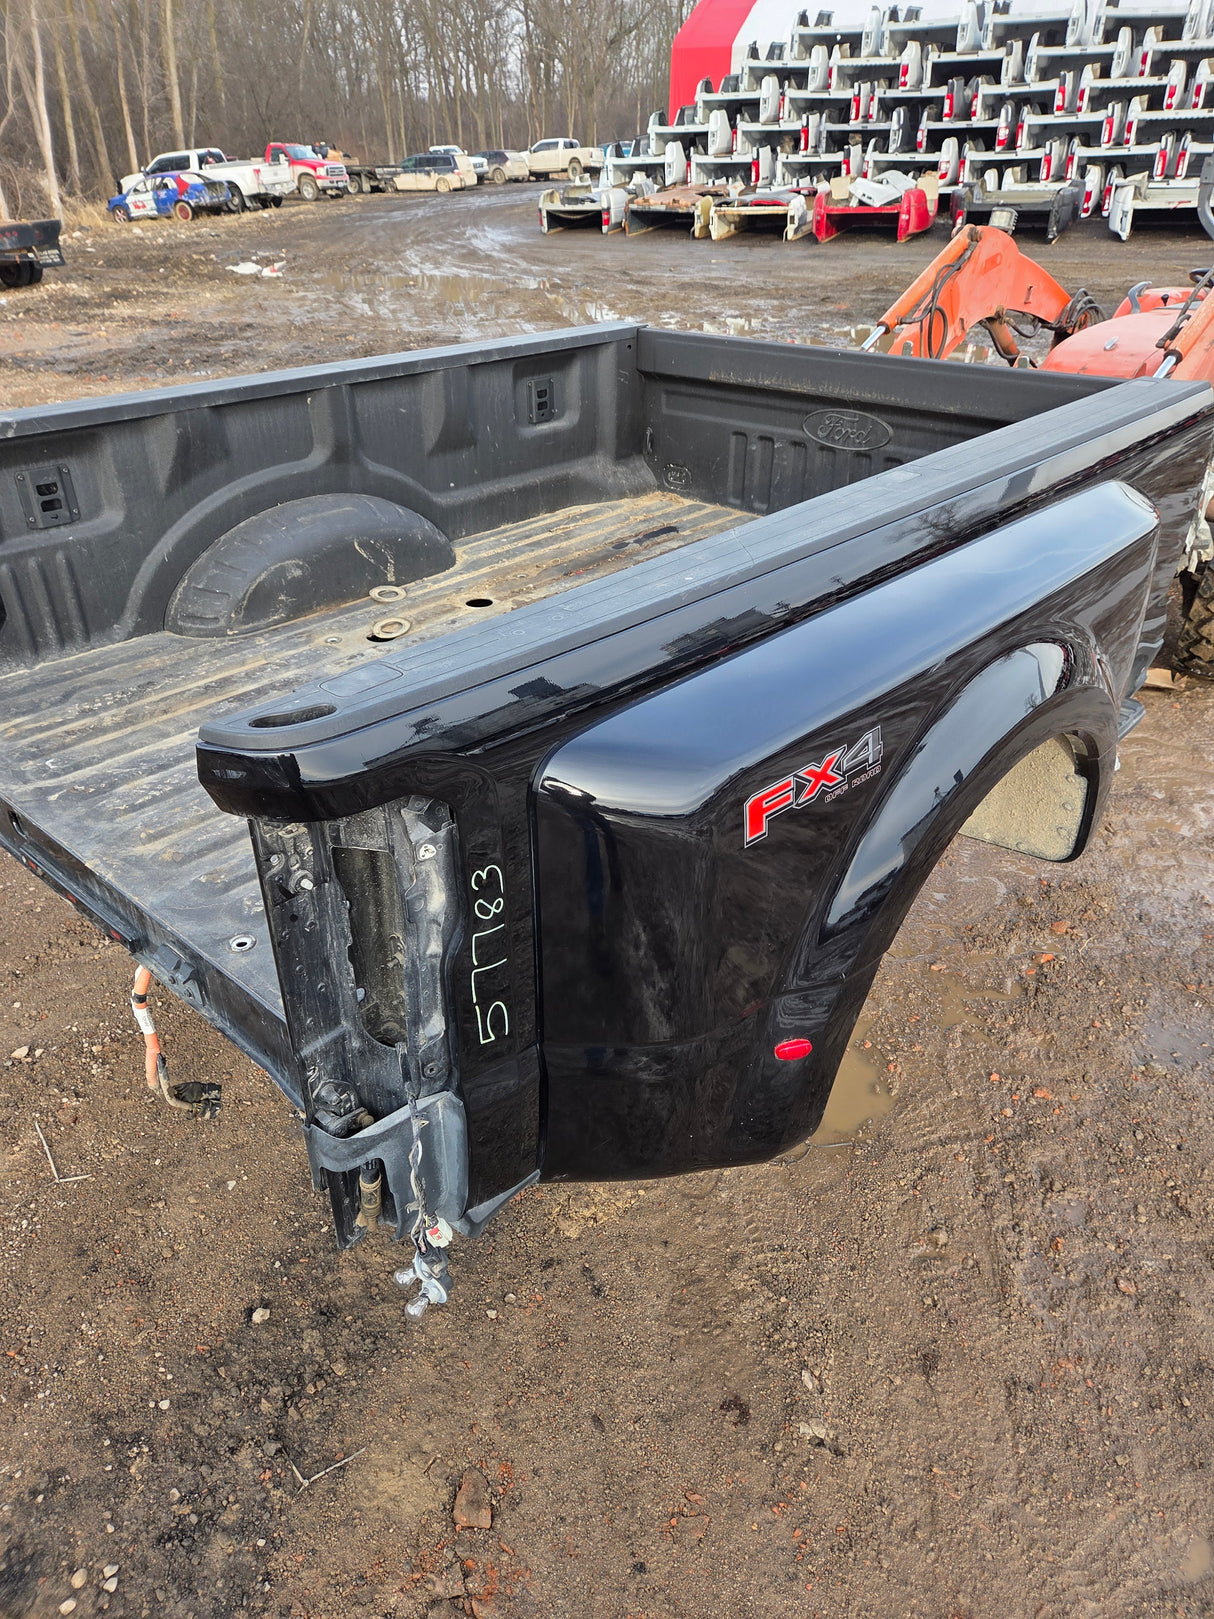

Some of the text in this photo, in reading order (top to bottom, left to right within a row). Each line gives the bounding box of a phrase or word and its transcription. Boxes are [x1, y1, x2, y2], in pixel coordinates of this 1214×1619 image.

[817, 413, 872, 443] Ford
[744, 725, 884, 848] FX4
[471, 865, 509, 1044] 57783
